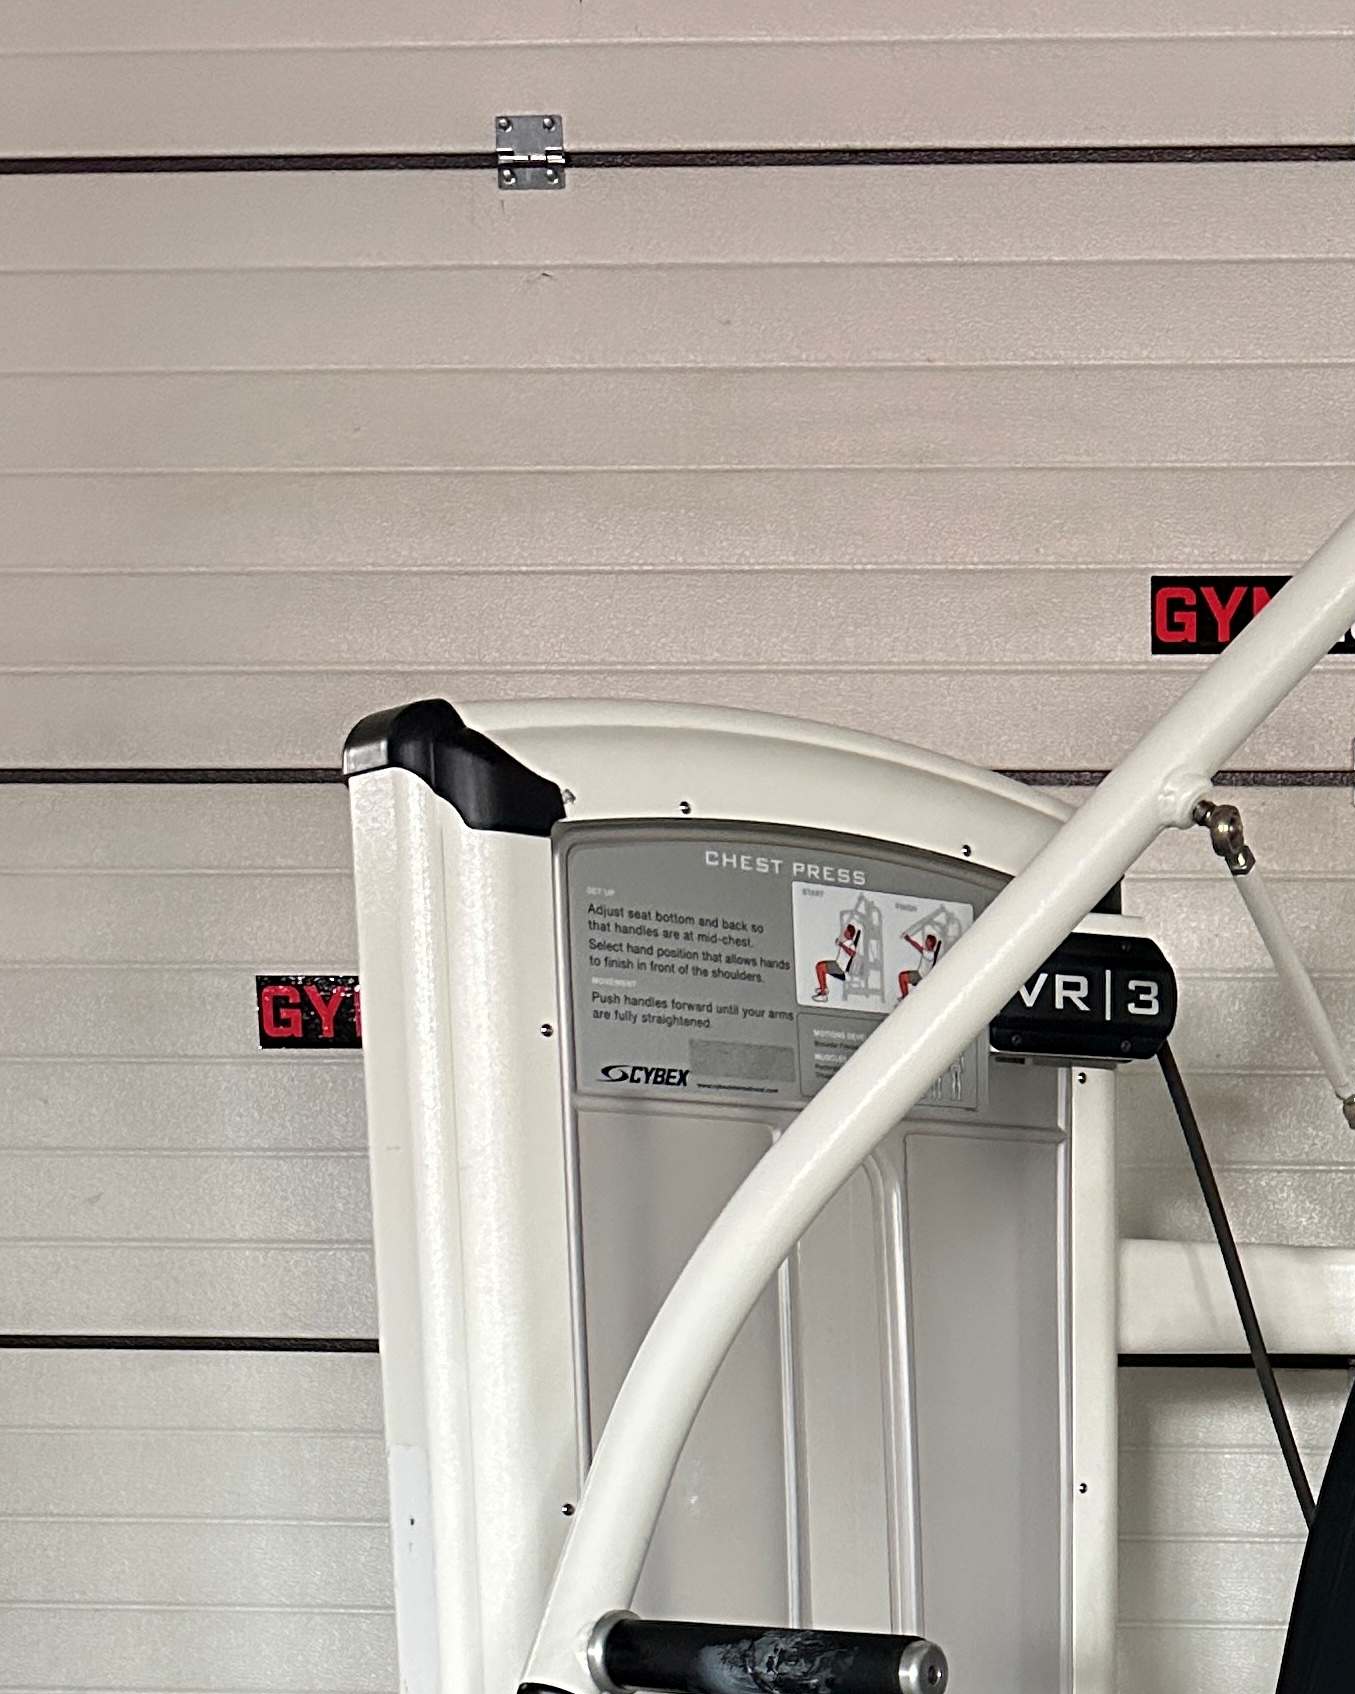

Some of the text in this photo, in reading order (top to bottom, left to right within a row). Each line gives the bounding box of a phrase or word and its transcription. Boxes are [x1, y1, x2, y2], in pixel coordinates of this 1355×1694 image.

[705, 850, 867, 886] CHEST PRESS
[588, 903, 764, 935] Adjust seat bottom and back so
[588, 920, 611, 934] that
[615, 922, 659, 939] handles
[662, 929, 680, 941] are
[683, 930, 694, 942] at
[589, 938, 791, 971] Select hand position that allows hands
[589, 955, 601, 968] to
[604, 956, 634, 970] finish
[637, 959, 647, 971] in
[650, 960, 675, 975] front
[678, 962, 689, 975] of
[692, 964, 709, 978] the
[592, 991, 795, 1022] Push handles forward until your arms
[592, 1009, 611, 1021] are
[614, 1009, 638, 1025] fully
[630, 1067, 690, 1087] CYBEX
